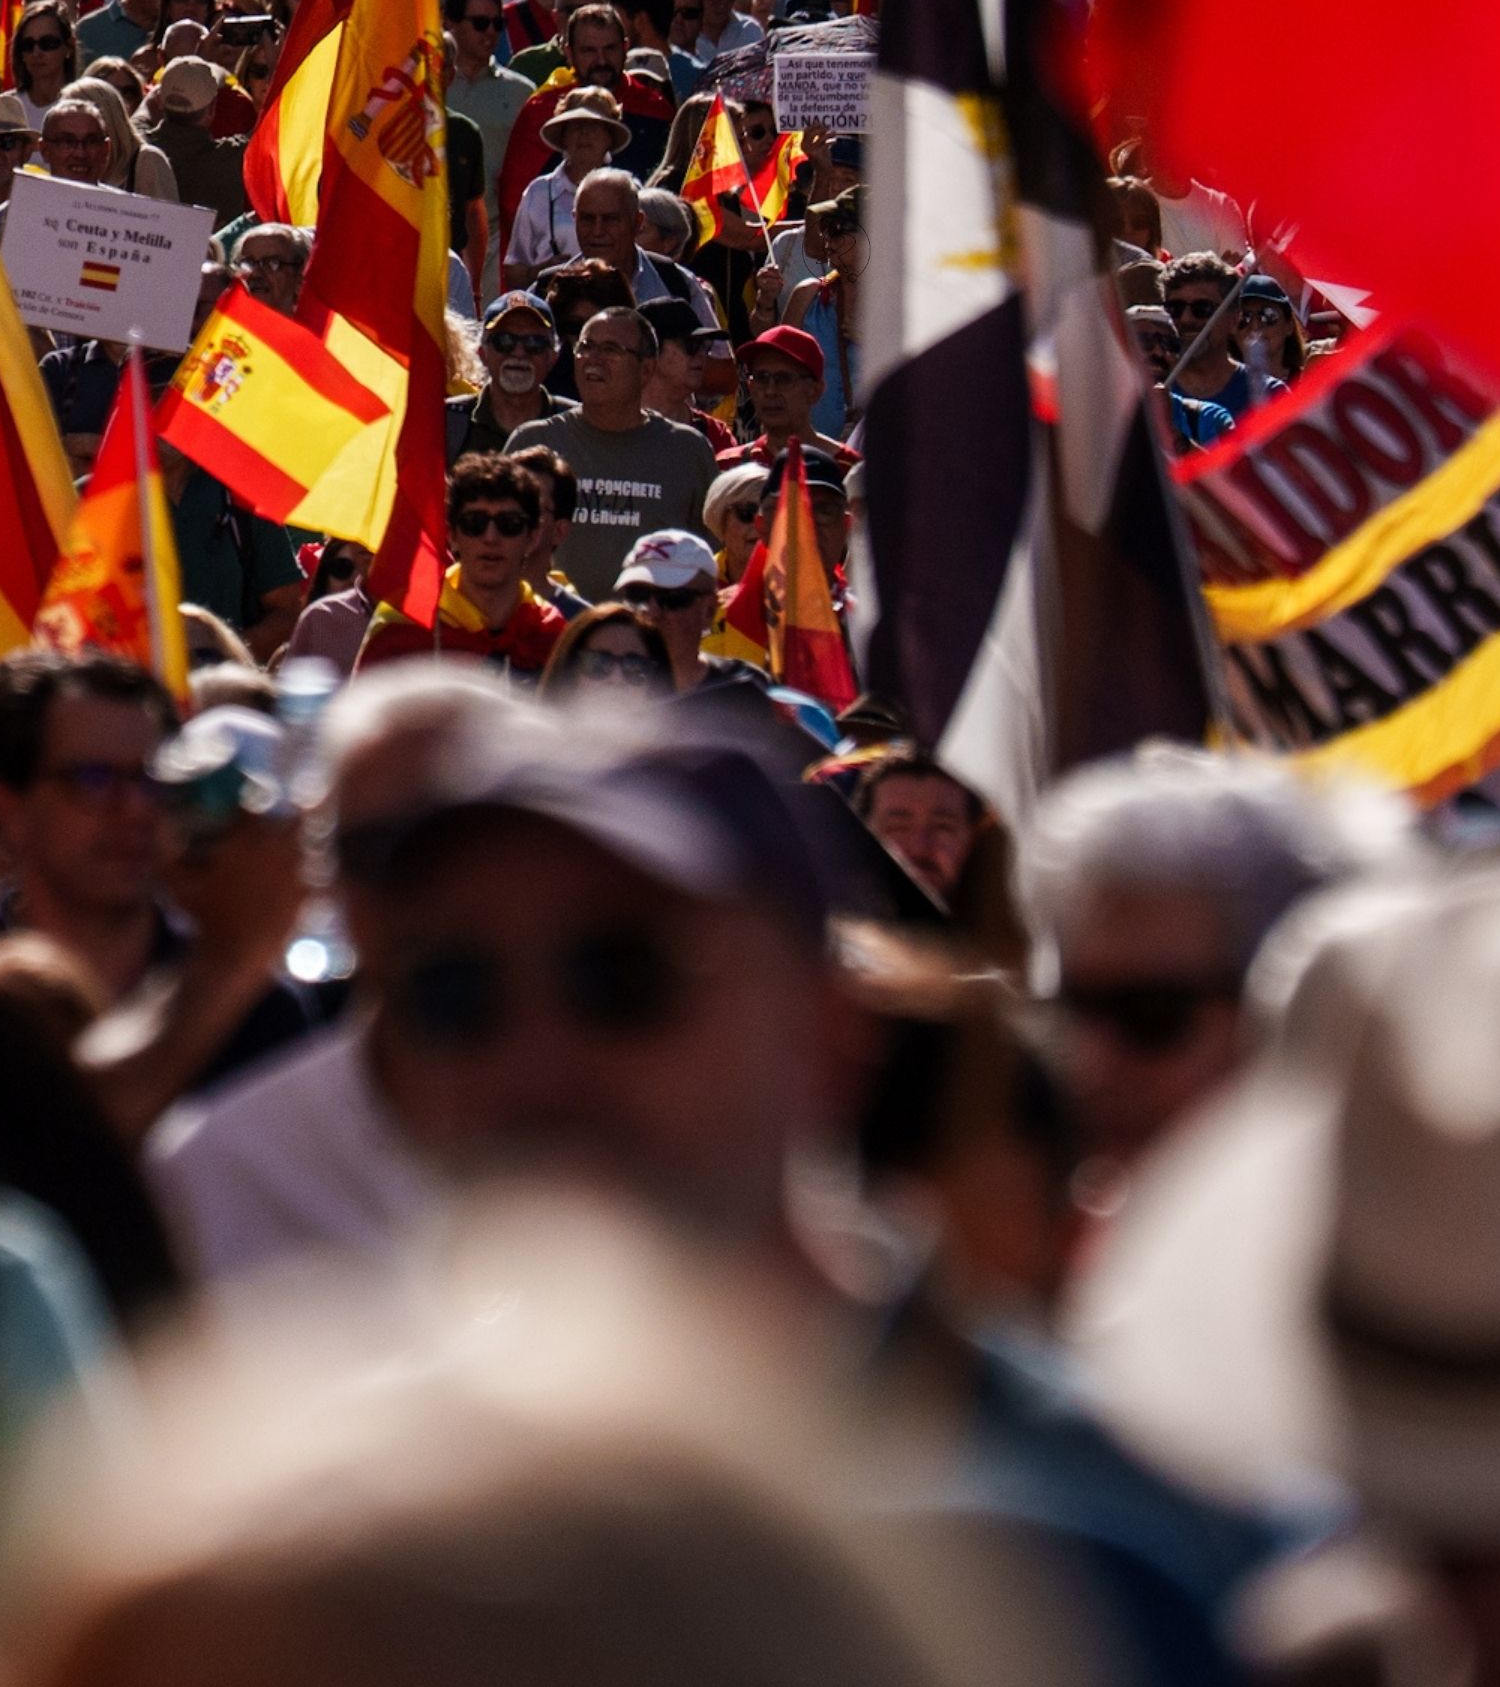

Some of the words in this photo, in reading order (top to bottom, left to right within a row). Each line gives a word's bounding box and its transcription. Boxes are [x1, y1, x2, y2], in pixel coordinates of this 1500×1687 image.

[805, 61, 825, 70] que
[781, 72, 794, 81] un
[822, 82, 842, 92] que
[844, 82, 858, 90] no
[778, 92, 790, 102] de
[792, 94, 803, 102] su
[789, 103, 798, 113] la
[800, 102, 841, 113] defensa
[843, 102, 857, 112] de
[779, 114, 797, 129] SU
[65, 218, 108, 238] Ceuta
[110, 230, 120, 242] y
[123, 229, 173, 251] Melilla
[57, 238, 79, 251] son
[86, 240, 152, 264] España
[594, 478, 662, 500] CONCRETE
